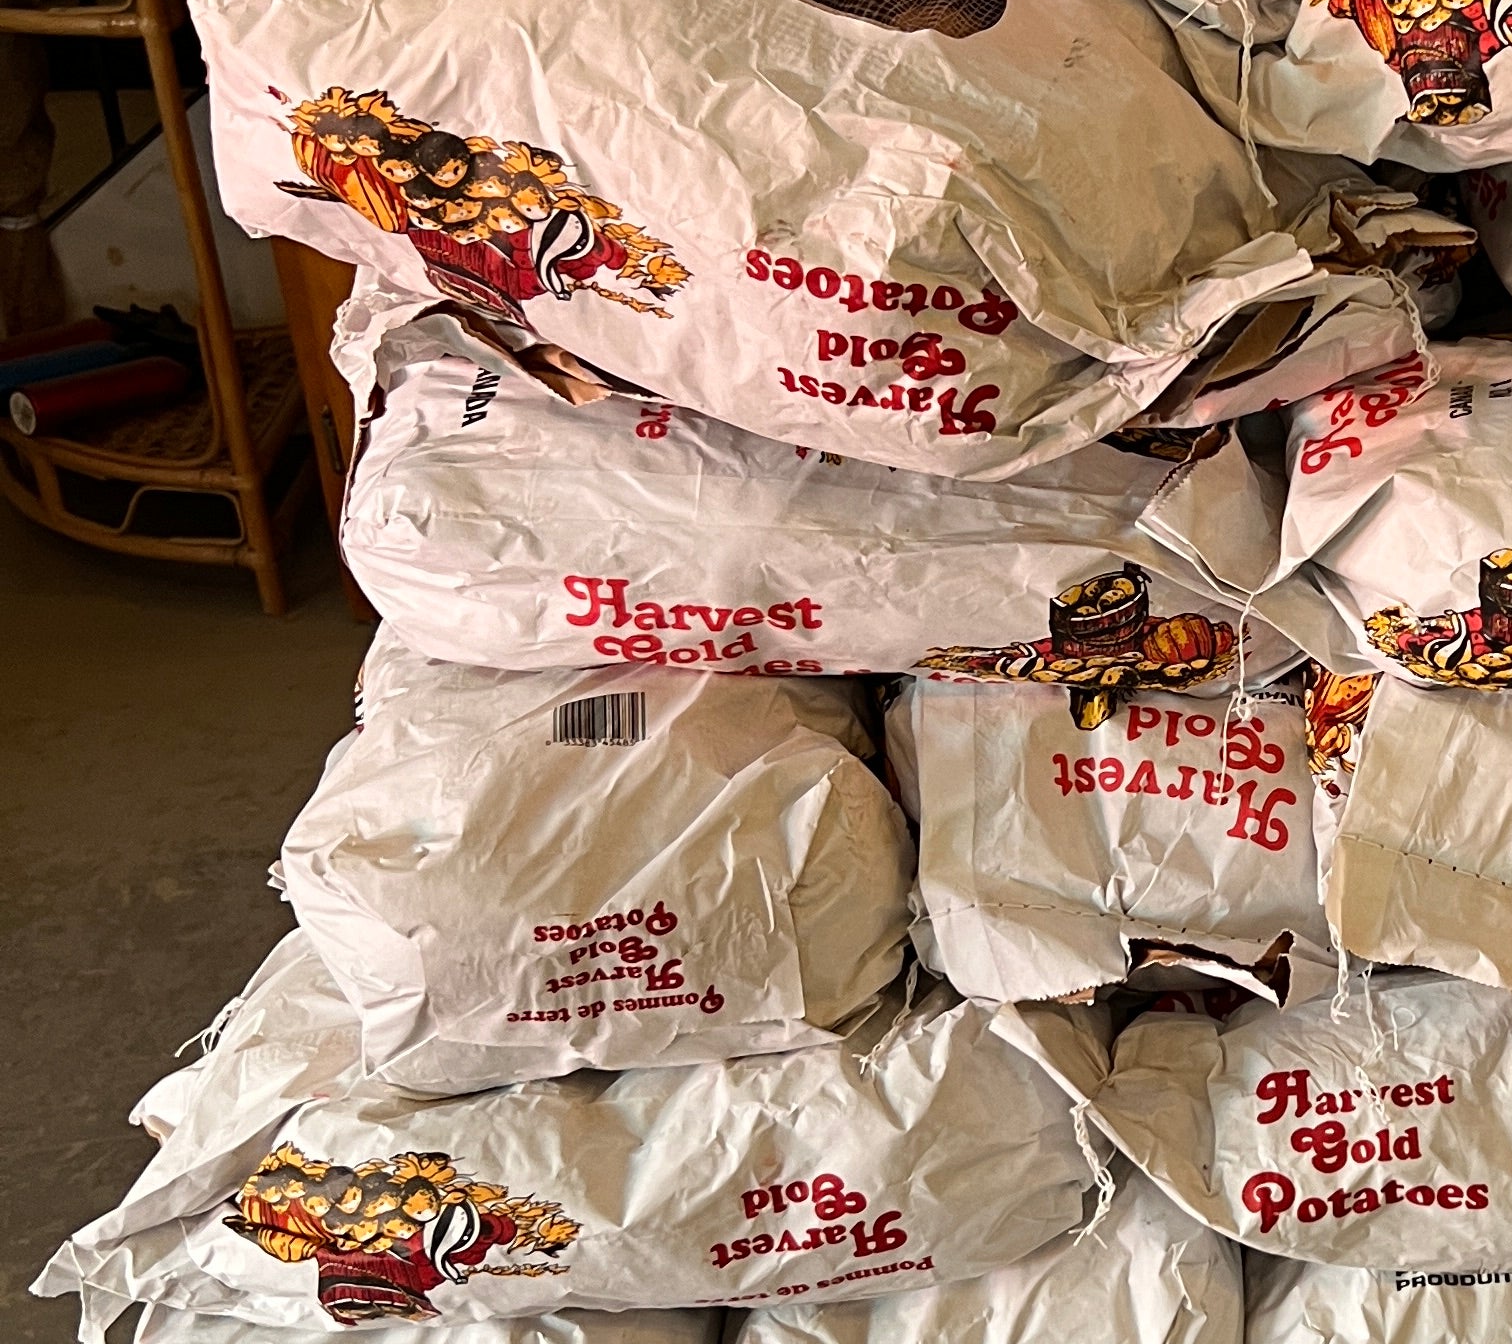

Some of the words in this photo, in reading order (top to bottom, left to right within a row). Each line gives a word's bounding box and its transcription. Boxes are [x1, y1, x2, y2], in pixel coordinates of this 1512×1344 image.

[745, 248, 1020, 337] Potatoes
[816, 328, 967, 381] Gold
[462, 367, 501, 428] ANADA
[778, 364, 1000, 437] Harvest
[563, 575, 823, 632] Harvest
[594, 632, 758, 665] Gold
[1127, 705, 1285, 774] Gold
[1052, 753, 1297, 852] Harvest
[533, 900, 678, 943] Potatoes
[545, 957, 686, 994] Harvest
[568, 935, 659, 966] Gold
[506, 1006, 572, 1025] terre
[577, 997, 607, 1019] de
[614, 984, 726, 1015] Pommes
[1255, 1068, 1455, 1126] Harvest
[1290, 1120, 1422, 1175] Gold
[740, 1173, 867, 1221] Gold
[1241, 1170, 1490, 1236] Potatoes
[709, 1210, 908, 1269] Harvest
[776, 1282, 810, 1297] de
[816, 1255, 936, 1289] Pommes
